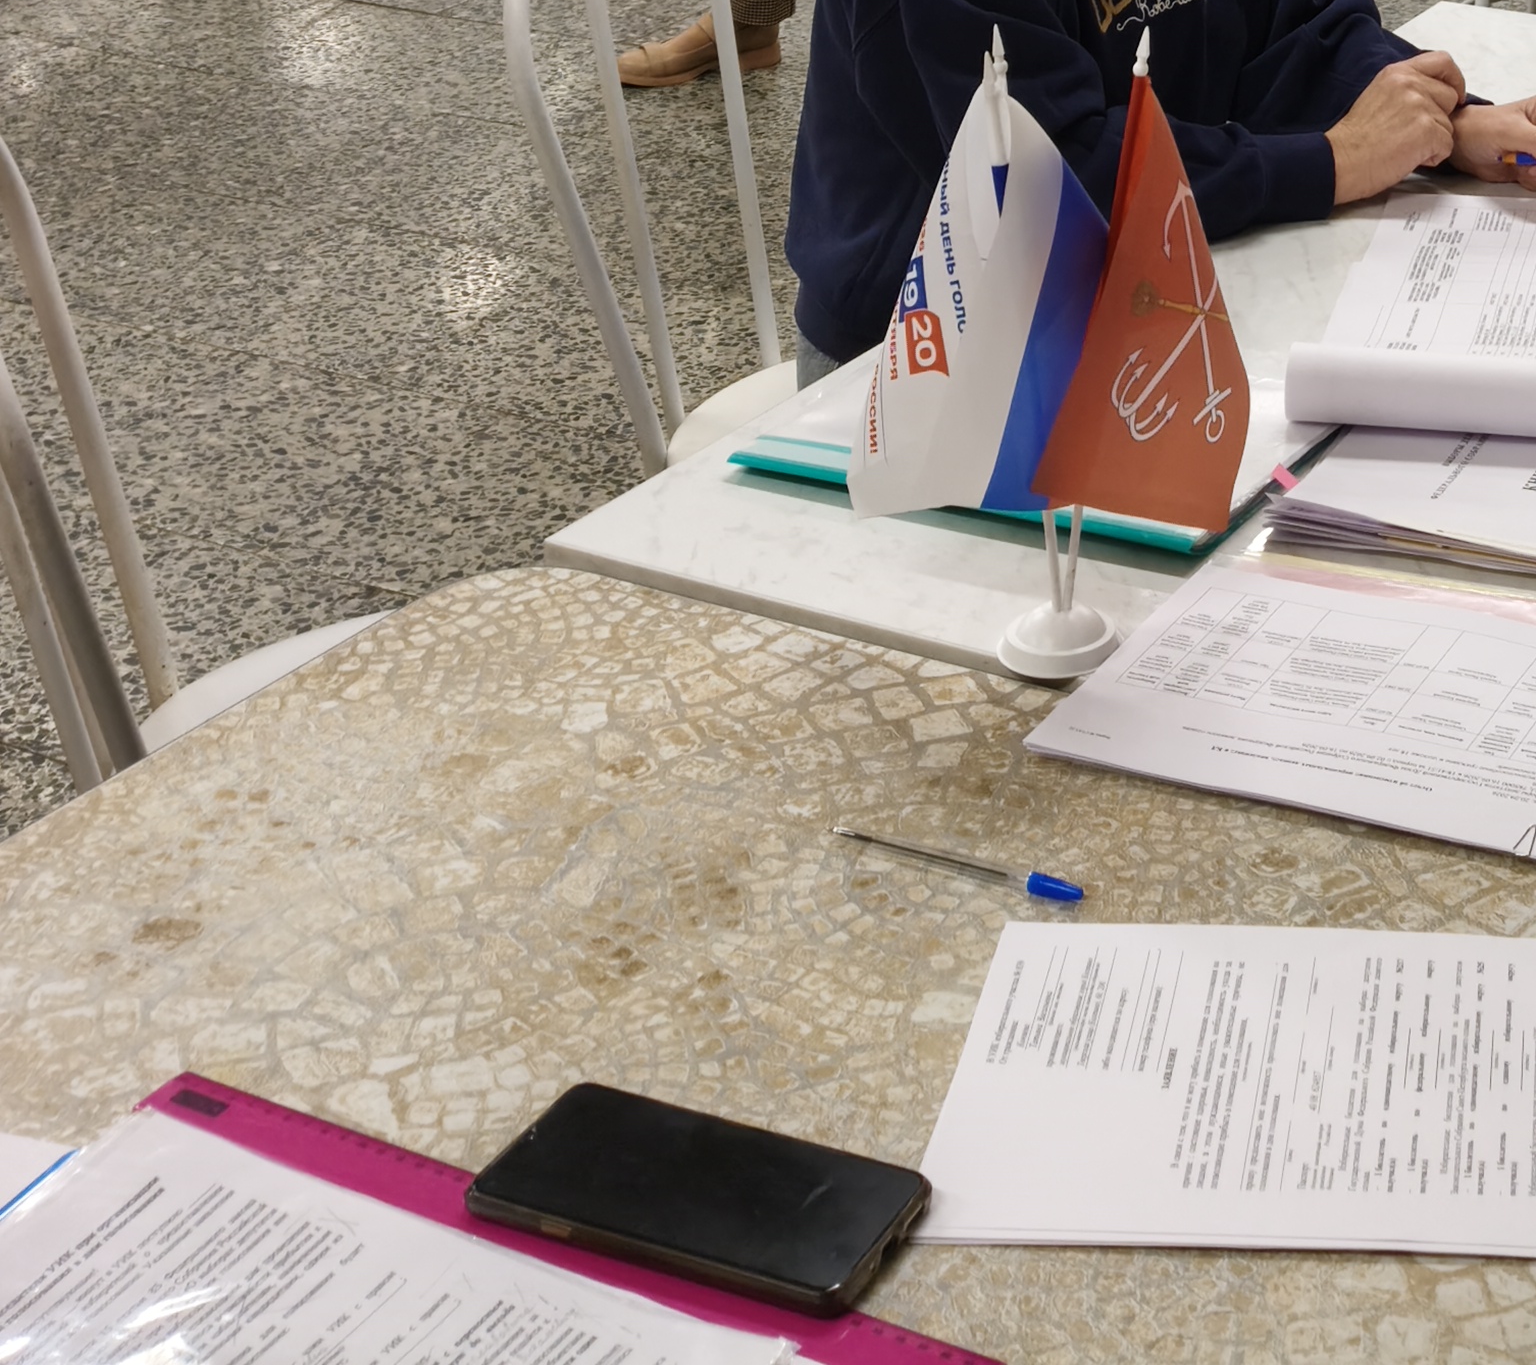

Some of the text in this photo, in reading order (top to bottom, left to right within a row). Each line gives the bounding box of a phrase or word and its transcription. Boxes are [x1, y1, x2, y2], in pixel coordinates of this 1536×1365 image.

[936, 220, 959, 275] ДЕНЬ
[903, 263, 920, 308] 19
[908, 313, 939, 368] 20
